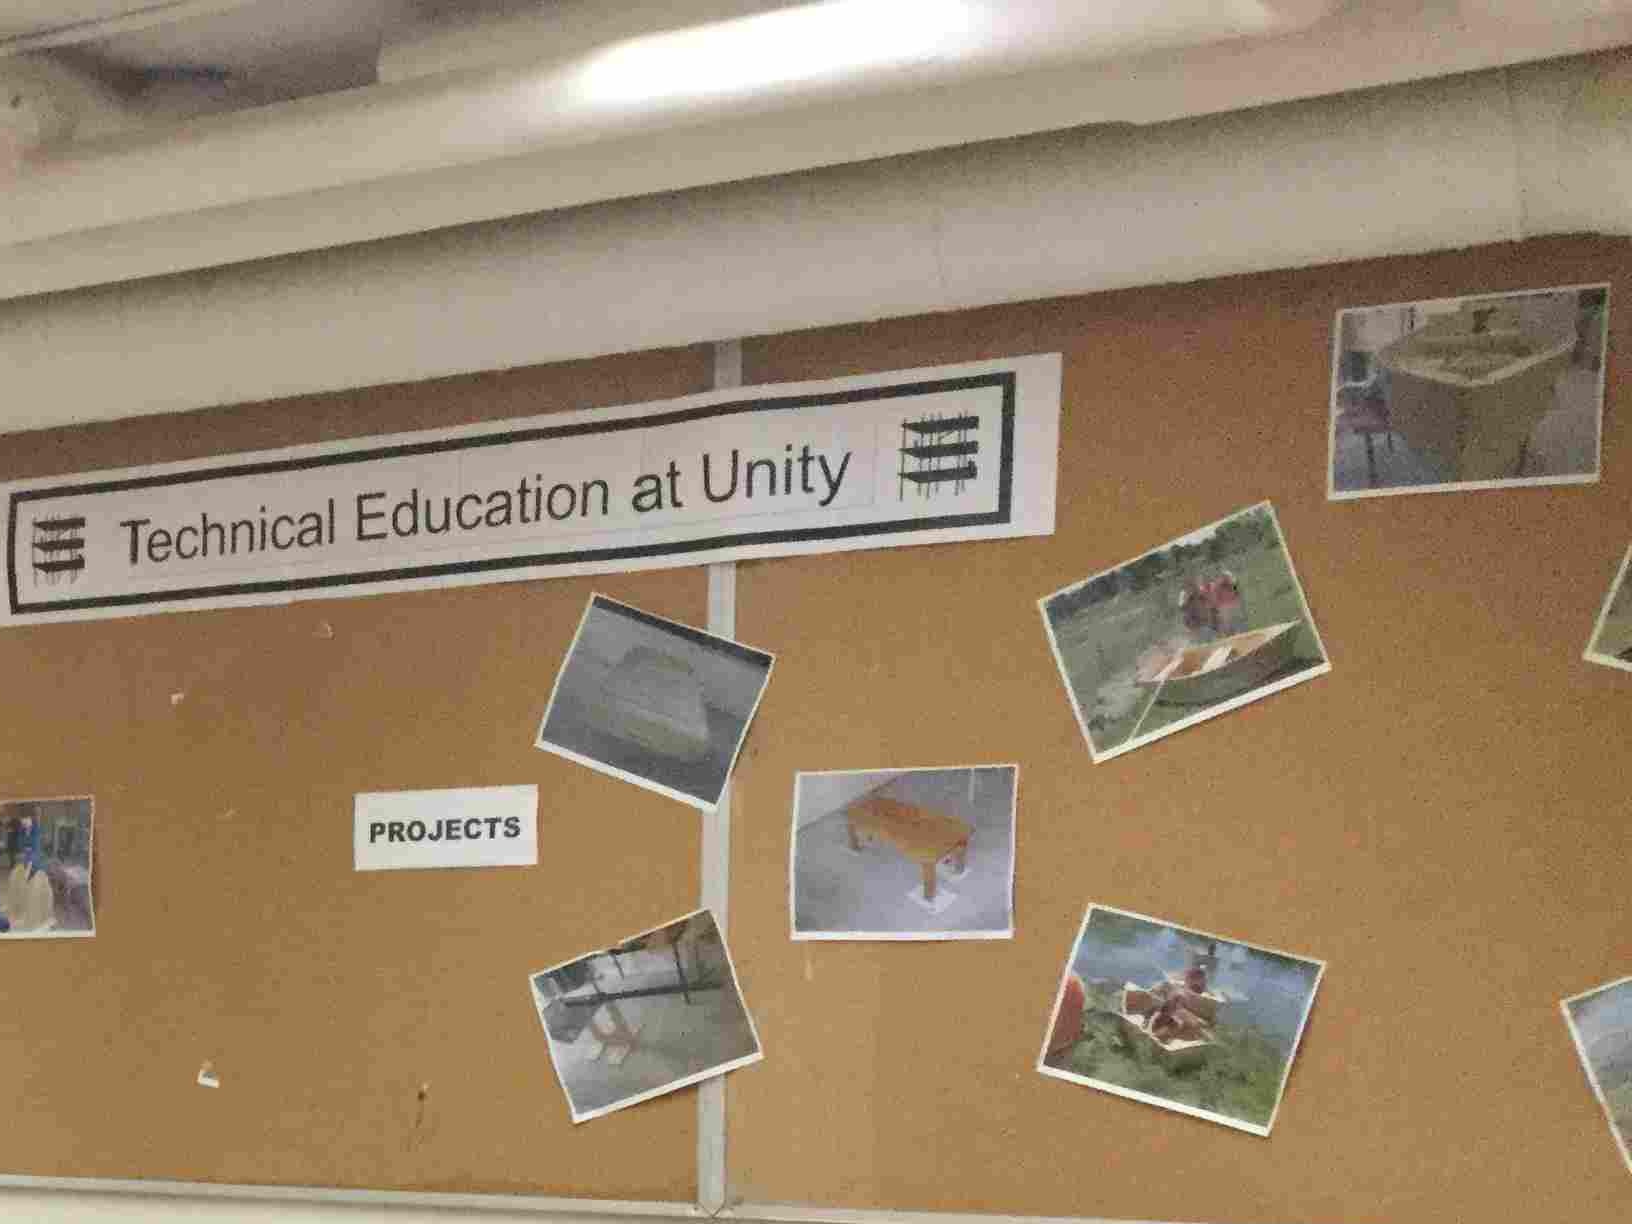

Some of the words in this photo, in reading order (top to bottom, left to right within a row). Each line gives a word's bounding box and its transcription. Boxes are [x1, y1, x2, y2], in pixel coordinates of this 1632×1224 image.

[119, 498, 335, 565] Technical
[356, 473, 609, 541] Education
[631, 460, 684, 513] at
[703, 443, 853, 507] Unity
[369, 815, 522, 843] PROJECTS
